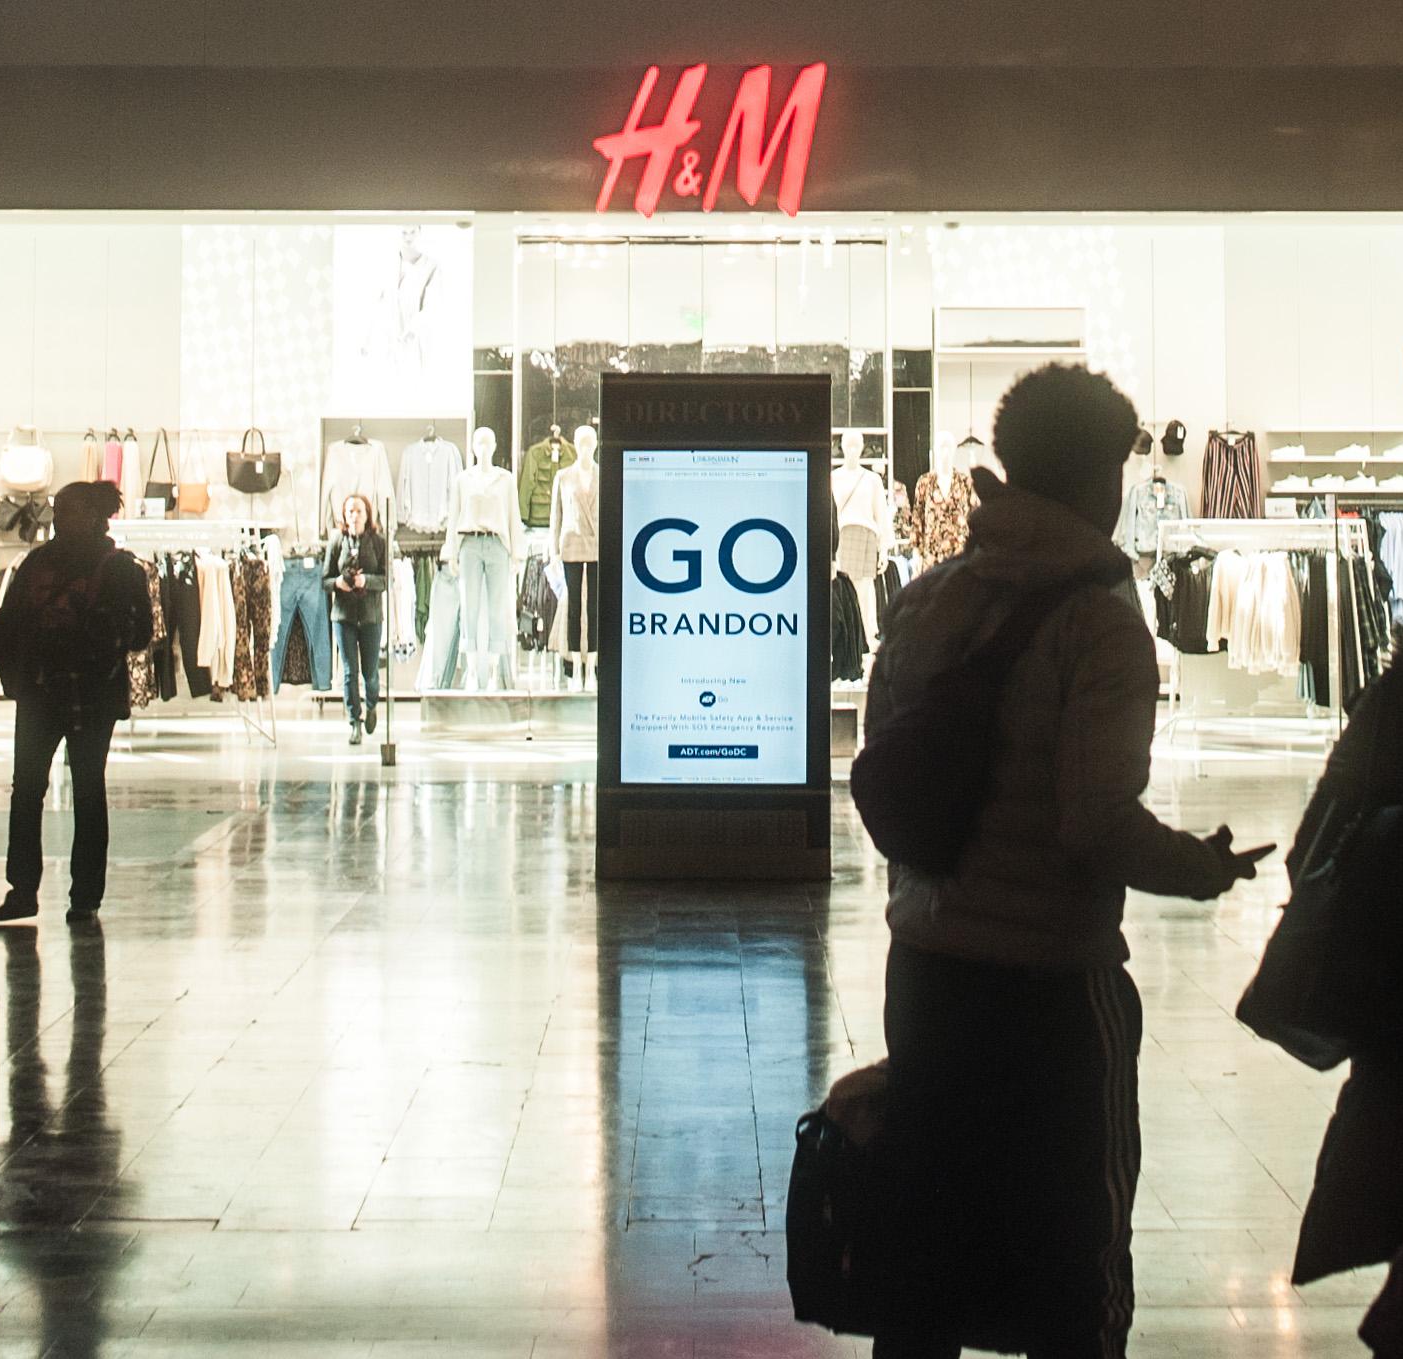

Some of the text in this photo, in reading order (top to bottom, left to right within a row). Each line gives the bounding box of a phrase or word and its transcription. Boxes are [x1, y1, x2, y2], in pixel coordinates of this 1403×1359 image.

[593, 62, 828, 218] H&M
[625, 400, 804, 425] DIRECTORY
[631, 518, 798, 594] GO
[629, 612, 798, 636] BRANDON
[681, 676, 727, 686] Introducing
[652, 714, 676, 723] Family
[710, 714, 734, 723] Safety
[738, 714, 753, 723] App
[630, 723, 668, 732] Equipped
[671, 723, 689, 731] With
[692, 723, 708, 731] SOS
[711, 723, 754, 732] Emergency
[680, 747, 748, 757] ADT.com/GoDC
